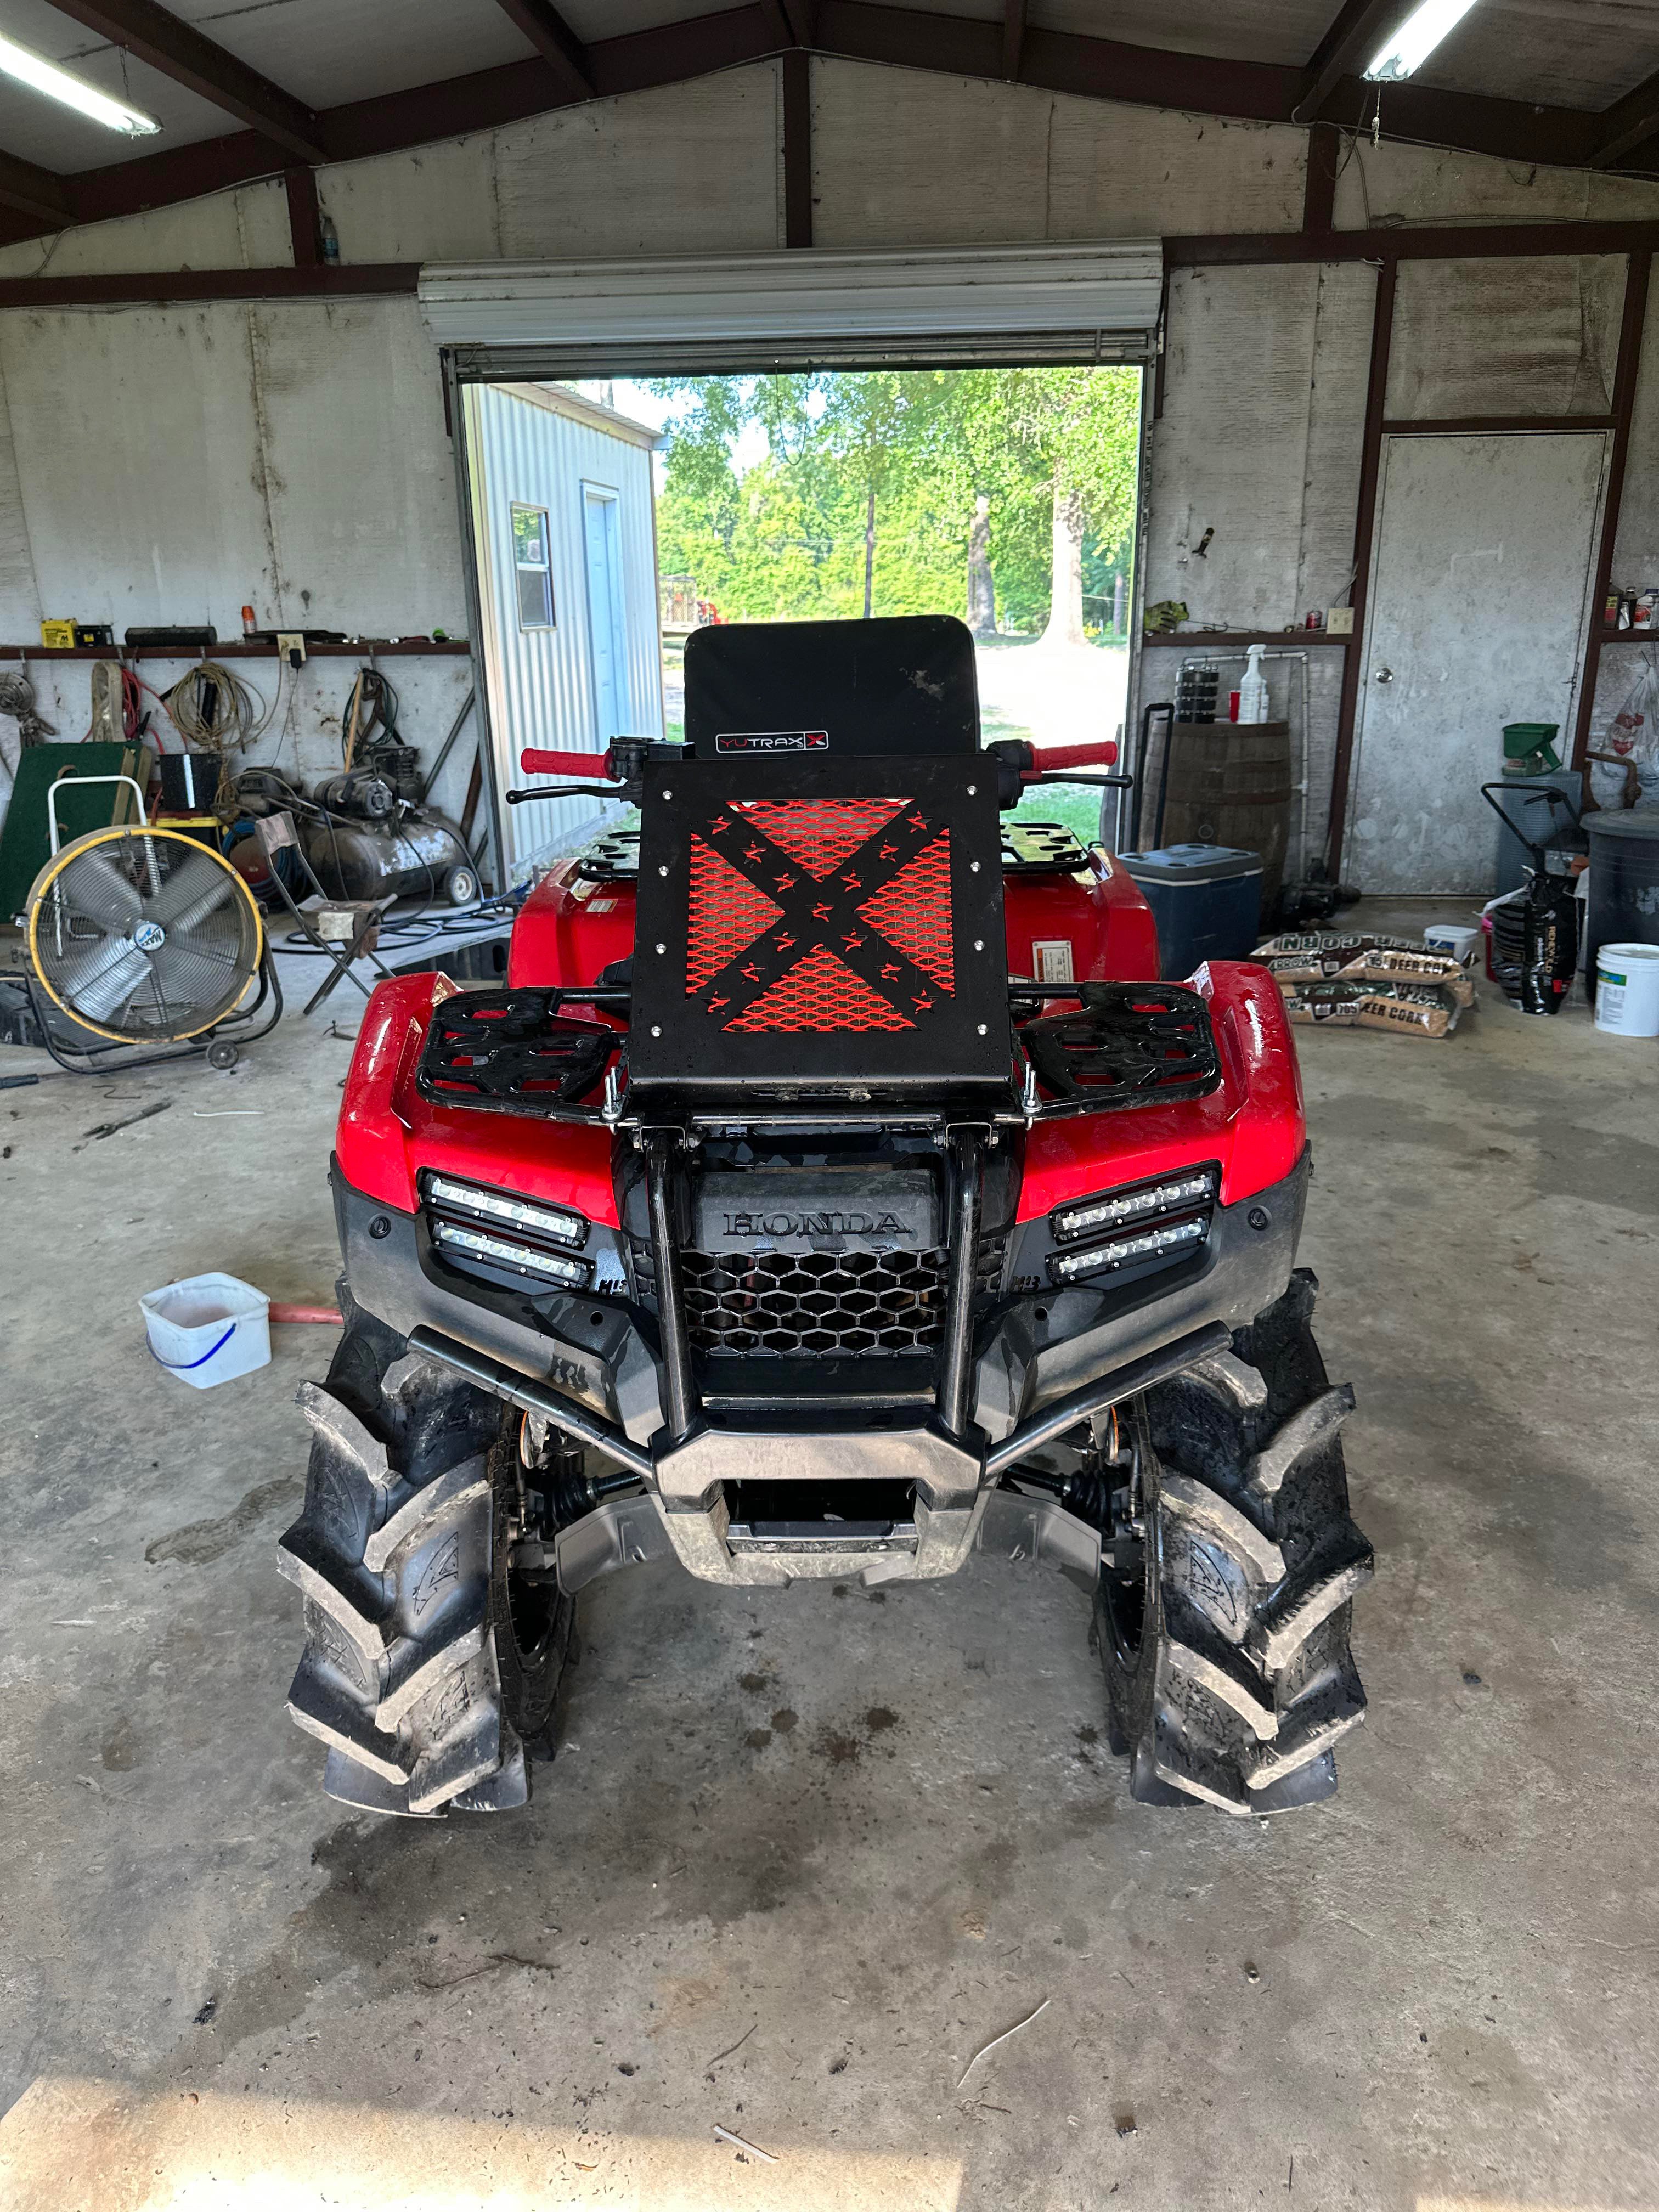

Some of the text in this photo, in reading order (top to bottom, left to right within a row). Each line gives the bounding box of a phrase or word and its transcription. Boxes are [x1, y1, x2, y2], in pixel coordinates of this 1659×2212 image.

[719, 736, 803, 749] YUTRAX
[1268, 955, 1314, 970] ARROW
[1338, 1004, 1357, 1014] 705
[723, 1210, 913, 1236] HONDA
